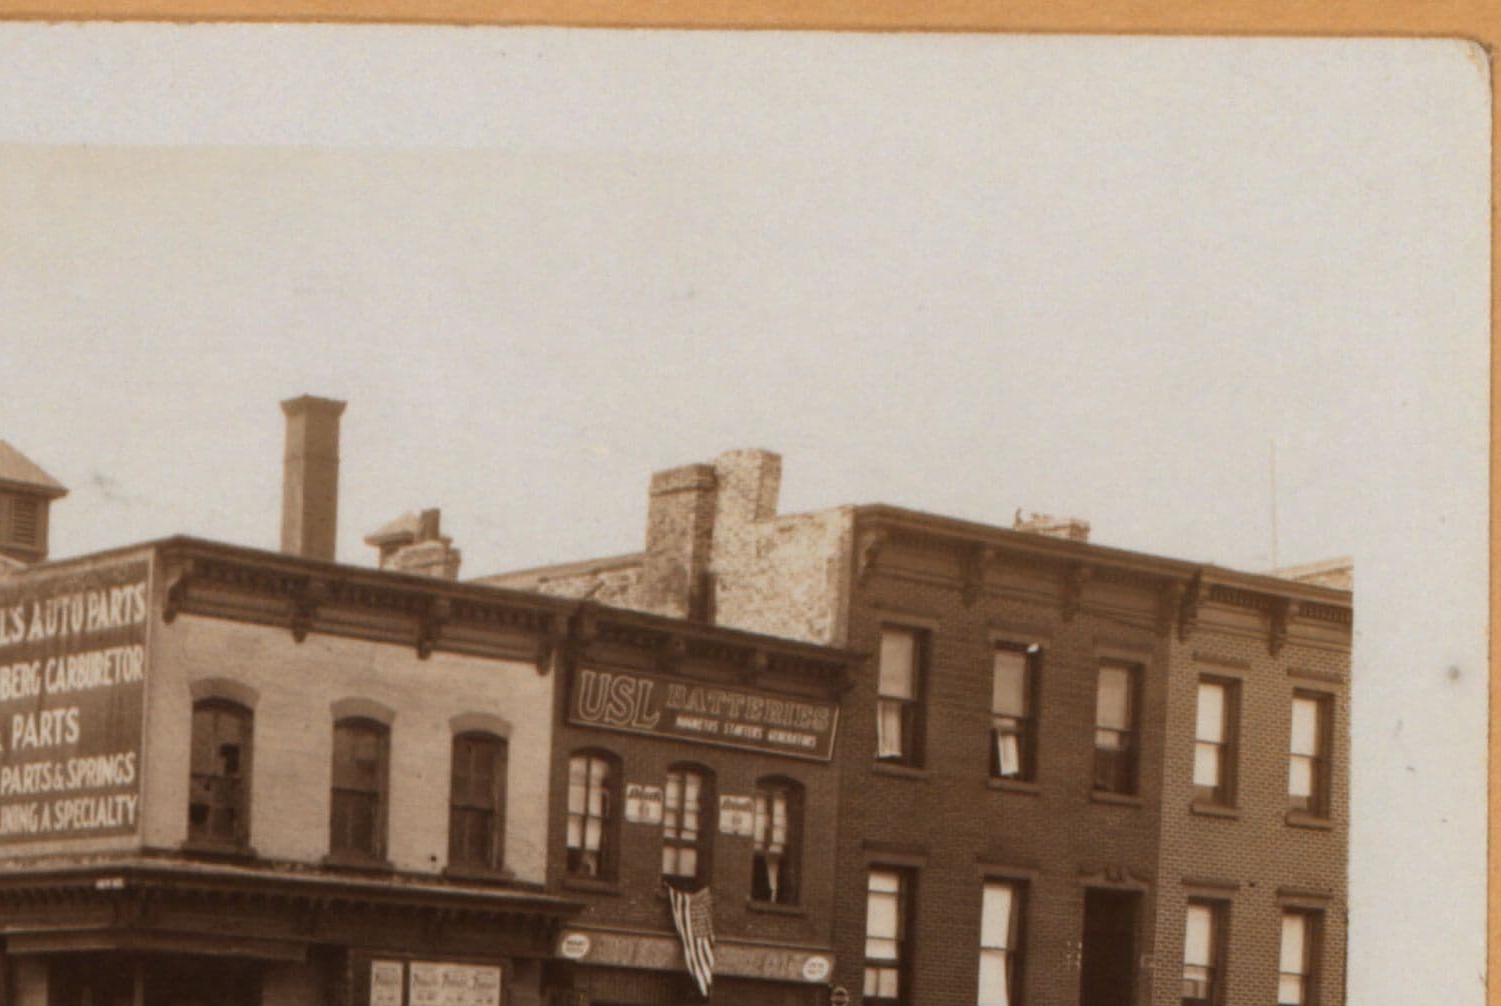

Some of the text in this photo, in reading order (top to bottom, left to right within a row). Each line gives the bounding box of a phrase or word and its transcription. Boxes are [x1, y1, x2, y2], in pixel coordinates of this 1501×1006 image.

[85, 581, 146, 633] PARTS
[577, 669, 661, 729] USL
[664, 682, 830, 732] BATTERIES
[11, 707, 81, 751] PARTS
[0, 761, 52, 797] PARTS
[52, 764, 64, 791] &
[65, 751, 137, 790] SPRINGS
[40, 801, 52, 833] A
[53, 794, 139, 831] SPECIALTY
